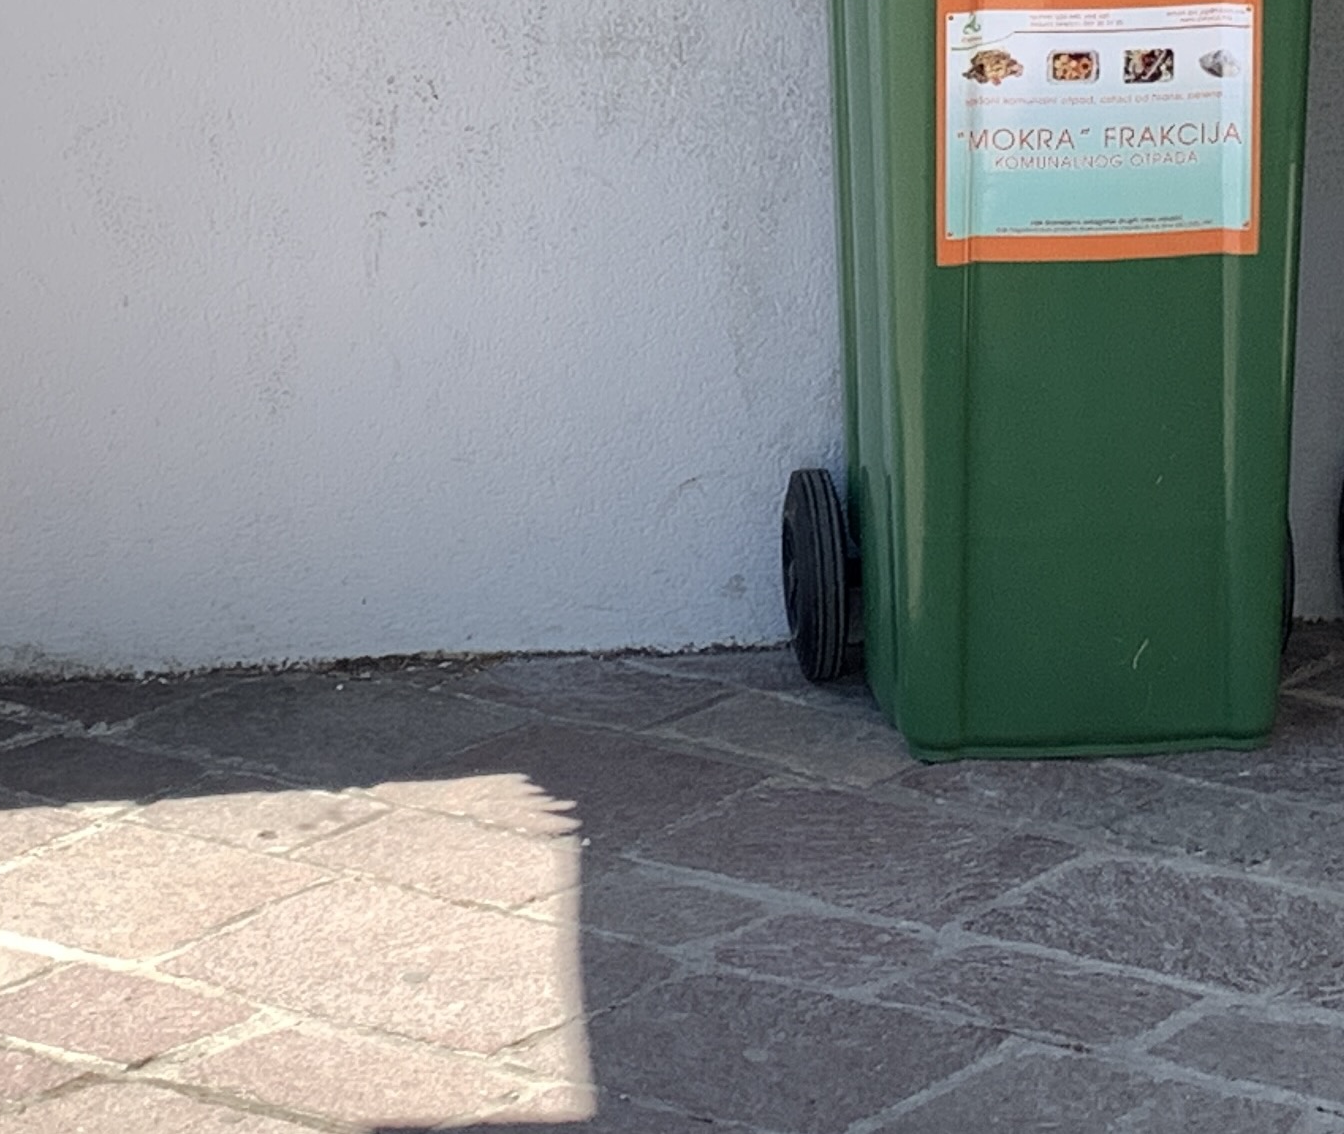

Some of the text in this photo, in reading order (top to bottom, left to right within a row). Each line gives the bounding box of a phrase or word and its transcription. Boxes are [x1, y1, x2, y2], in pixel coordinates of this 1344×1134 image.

[1104, 122, 1242, 149] FRAKCIJA
[995, 151, 1199, 170] KOMUNALNOG OTPADA
